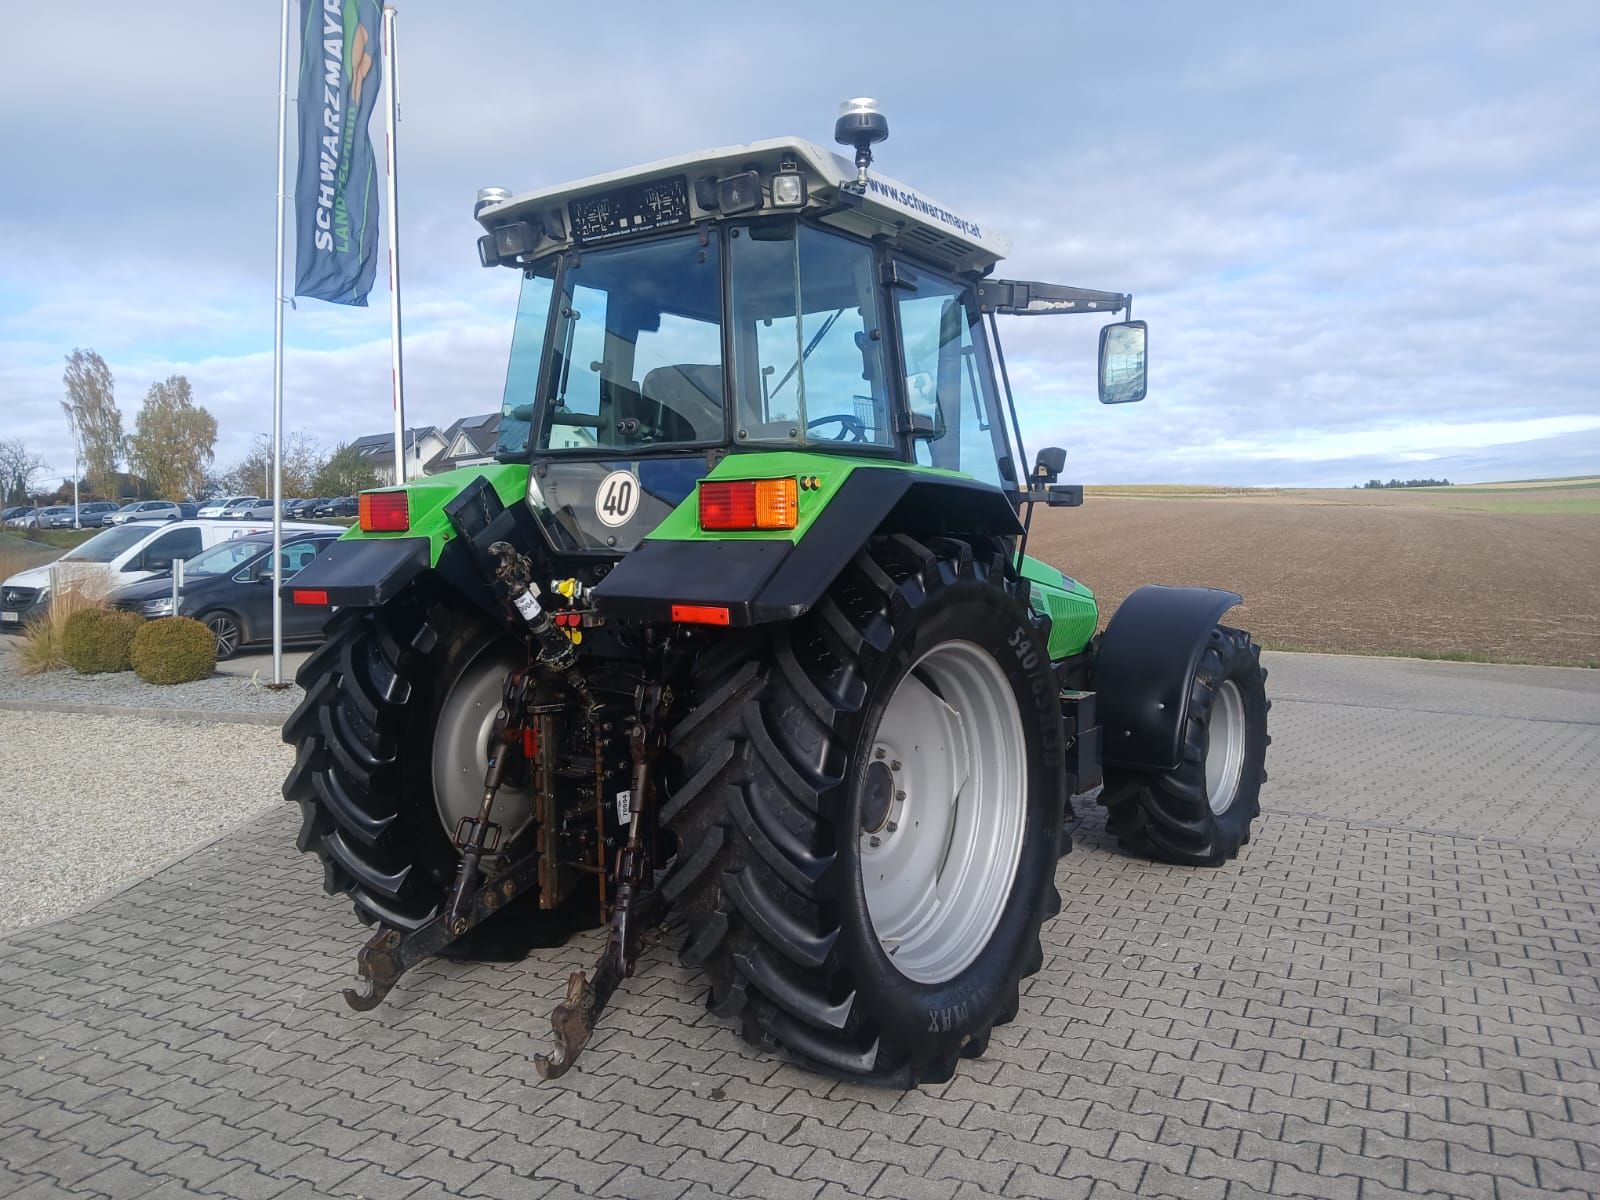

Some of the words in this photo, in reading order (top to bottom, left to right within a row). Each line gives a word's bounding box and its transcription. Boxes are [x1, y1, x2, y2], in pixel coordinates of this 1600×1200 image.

[315, 0, 343, 252] SCHWARZMAYR
[868, 178, 982, 239] www.schwarzmayr.at
[603, 481, 632, 516] 40
